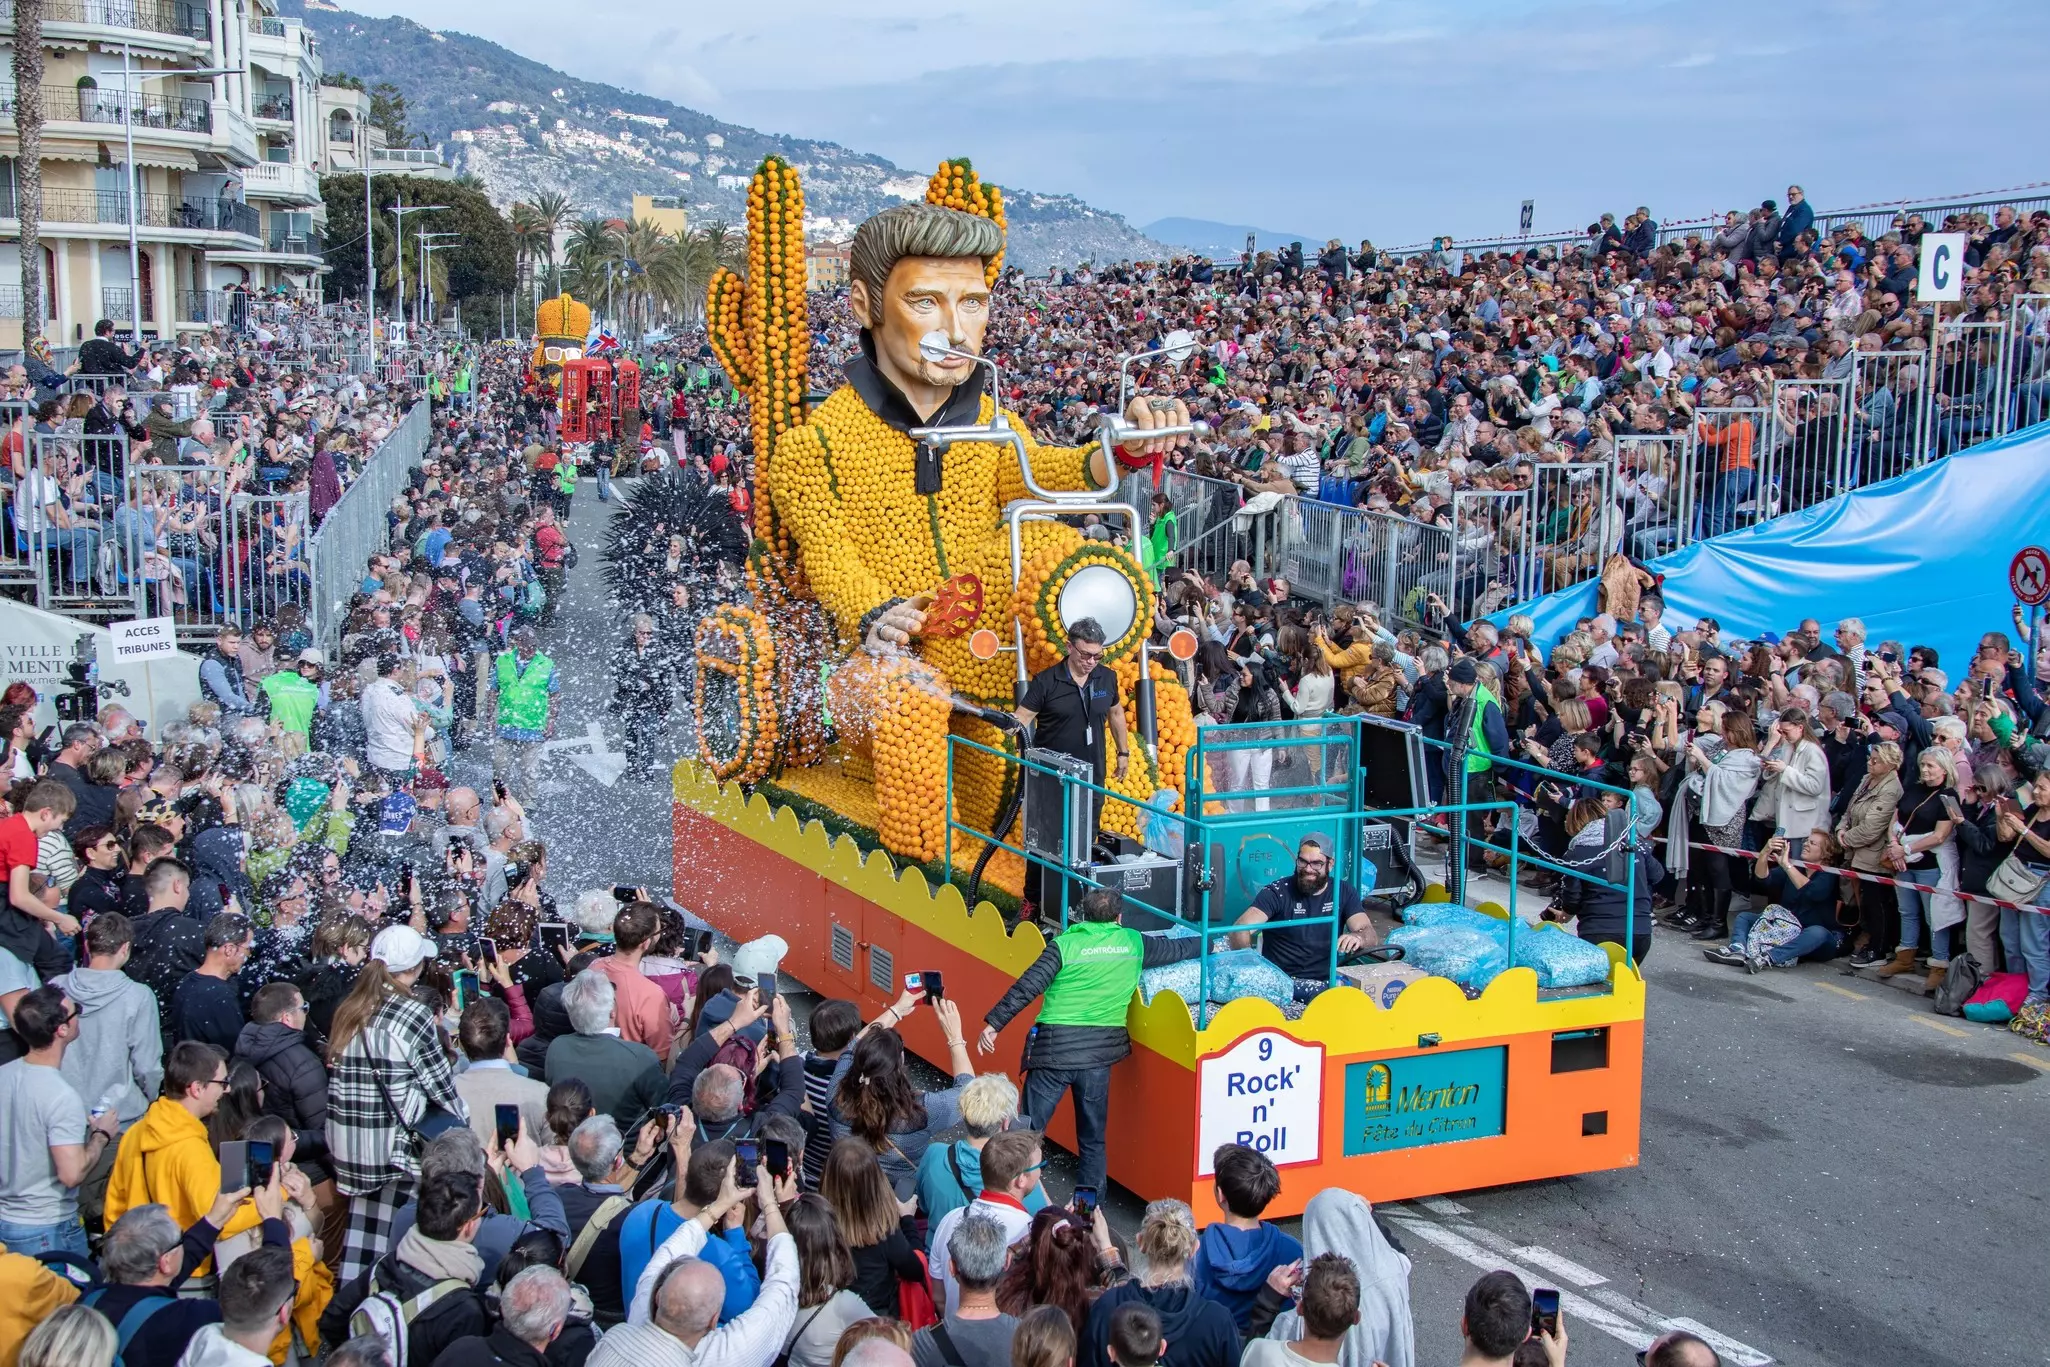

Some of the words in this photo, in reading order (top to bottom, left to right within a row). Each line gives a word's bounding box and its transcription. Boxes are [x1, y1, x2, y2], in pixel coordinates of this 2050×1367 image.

[1521, 205, 1533, 228] C2
[1933, 244, 1950, 290] C
[391, 325, 404, 341] D1
[125, 625, 160, 638] ACCES
[7, 645, 62, 657] VILLE
[117, 641, 171, 656] TRIBUNES
[1081, 945, 1129, 956] CONTRÔLEUR
[1259, 1037, 1272, 1061] 9
[1228, 1064, 1300, 1097] Rock'
[1395, 1081, 1480, 1114] Menton
[1253, 1098, 1274, 1123] n'
[1236, 1126, 1286, 1152] Roll
[1363, 1123, 1399, 1143] Fête
[1404, 1119, 1424, 1136] du
[1428, 1116, 1476, 1134] Citron
